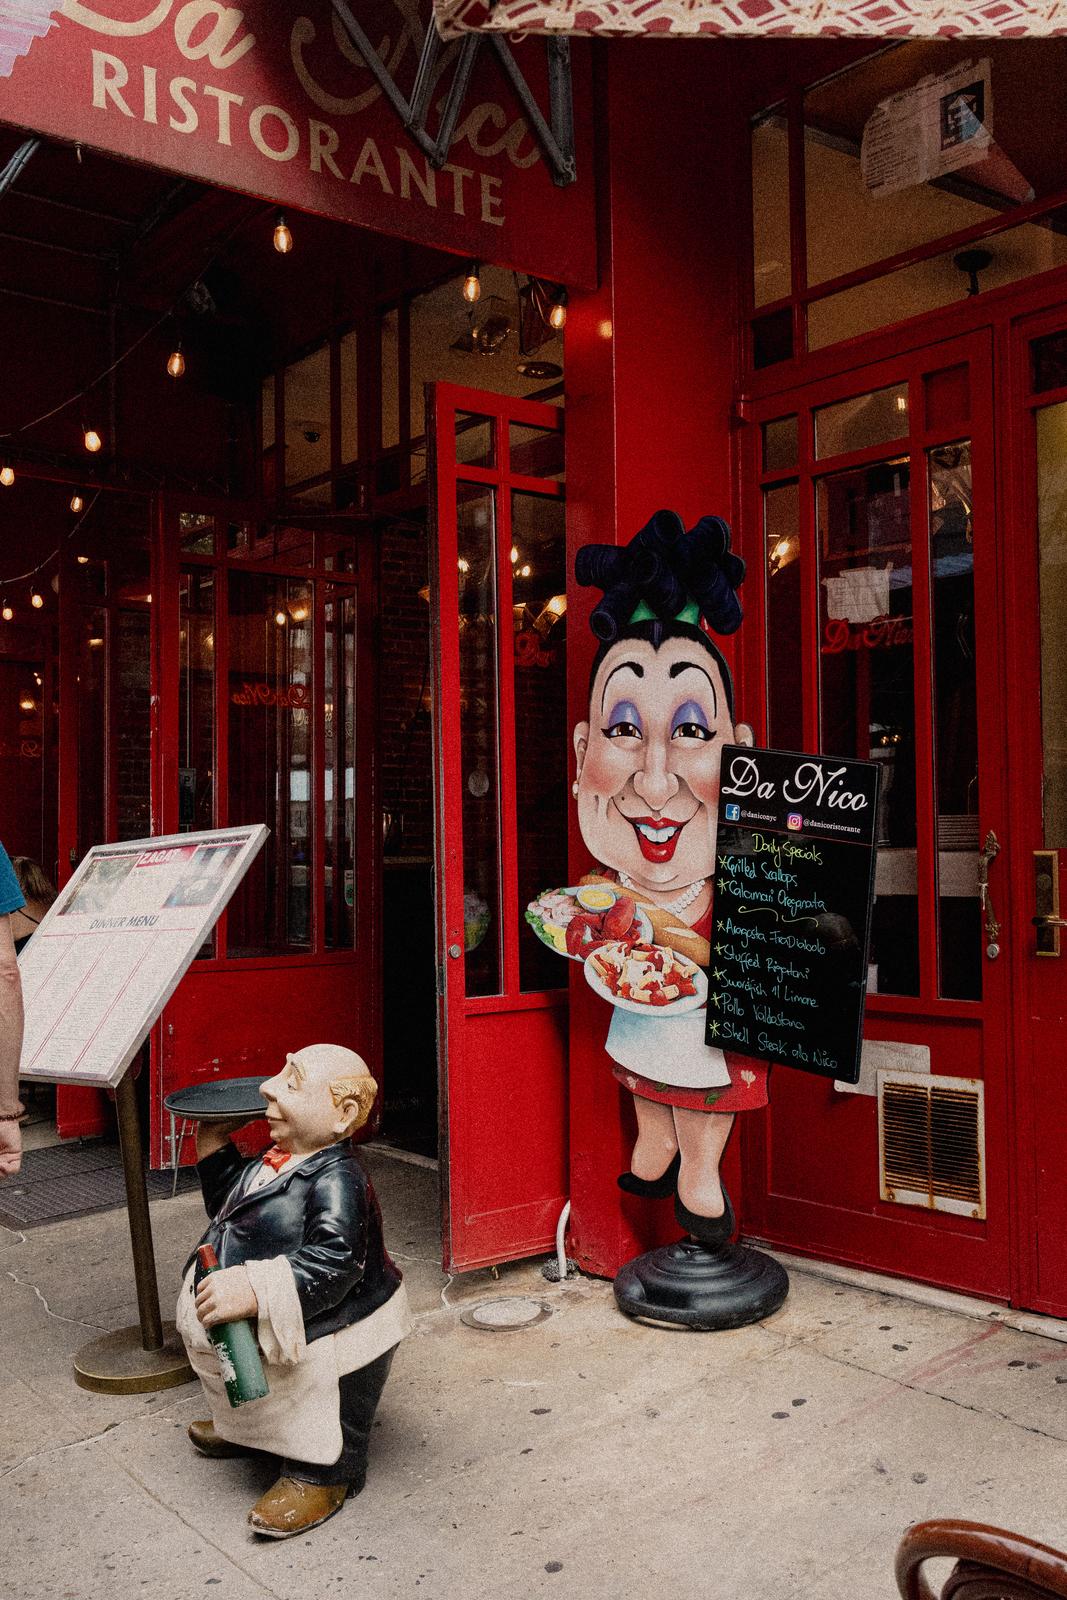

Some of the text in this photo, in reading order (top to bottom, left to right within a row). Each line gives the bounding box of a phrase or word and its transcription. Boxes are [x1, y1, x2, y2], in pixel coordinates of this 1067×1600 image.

[91, 48, 507, 227] RISTORANTE
[721, 756, 869, 812] Da Nico
[740, 809, 777, 822] @daniconyc
[803, 817, 861, 834] @danicoristorante
[751, 832, 823, 868] Daily Specials
[726, 856, 798, 891] Grilled Scallops
[728, 880, 774, 903] Calamari
[126, 915, 160, 928] MENU
[723, 944, 761, 973] Stuffed
[720, 992, 745, 1017] Pollo
[721, 1021, 749, 1044] Shell
[757, 1031, 788, 1057] Steak
